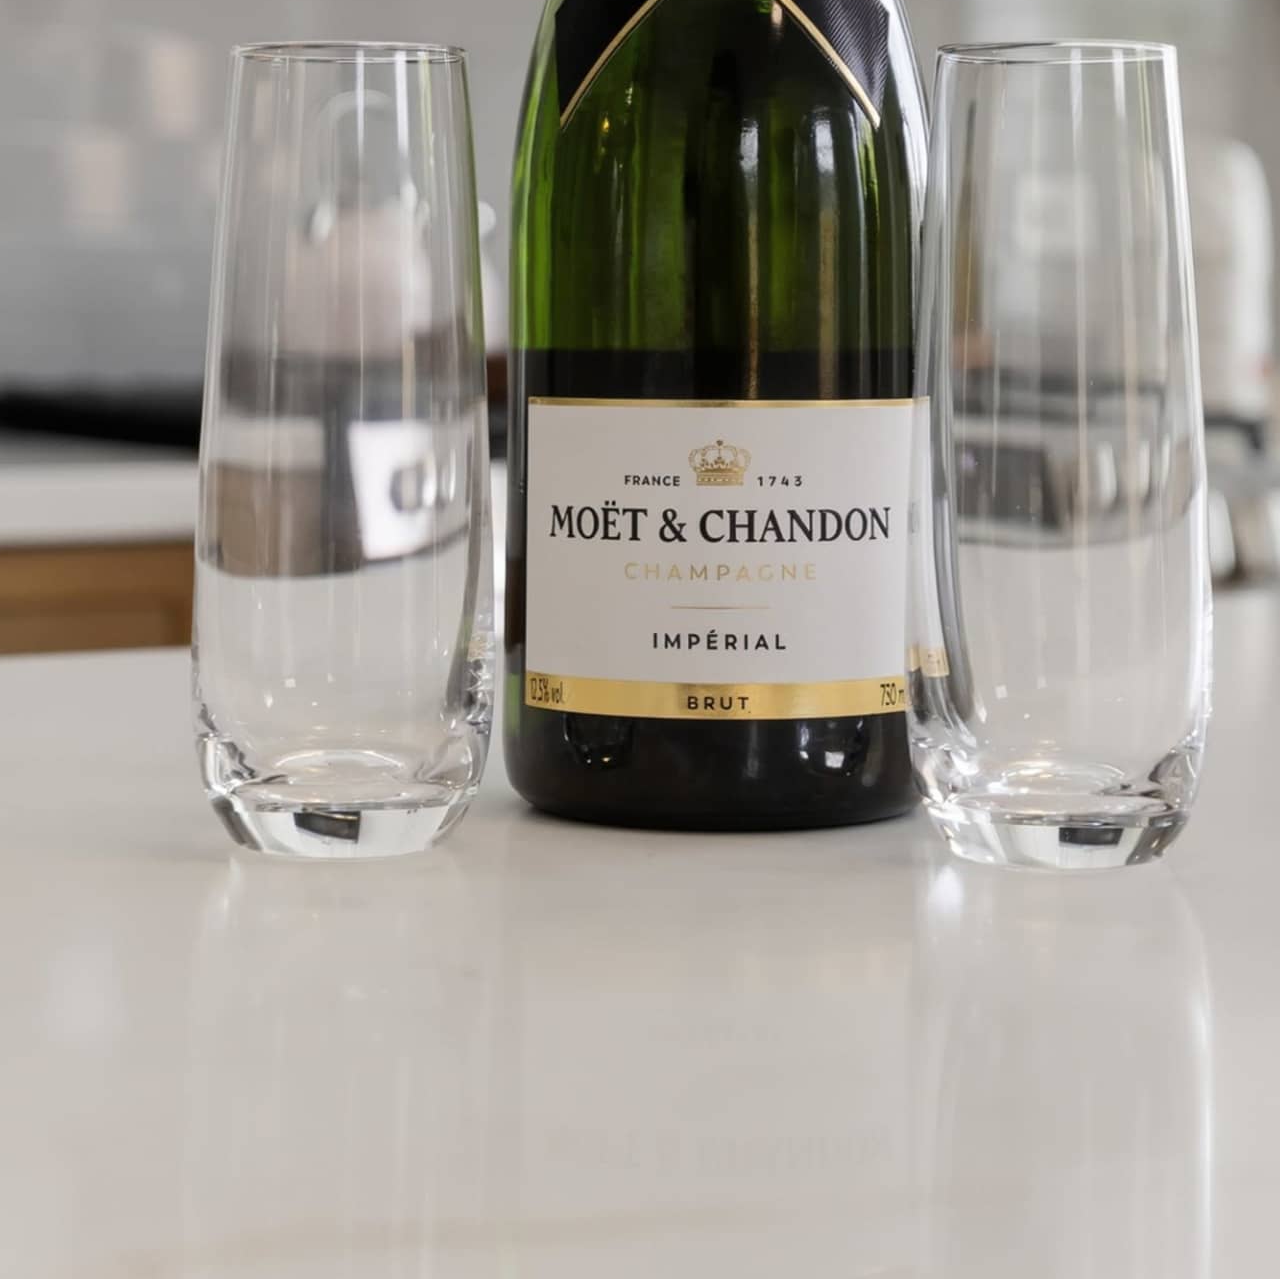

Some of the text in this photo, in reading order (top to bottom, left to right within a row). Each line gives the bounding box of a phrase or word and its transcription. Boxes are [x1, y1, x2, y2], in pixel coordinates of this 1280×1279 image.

[623, 474, 803, 488] FRANCE 1743
[549, 500, 891, 544] MOËT & CHANDON
[623, 561, 818, 582] CHAMPAGNE
[652, 628, 787, 652] IMPÉRIAL
[686, 695, 749, 711] BRUT
